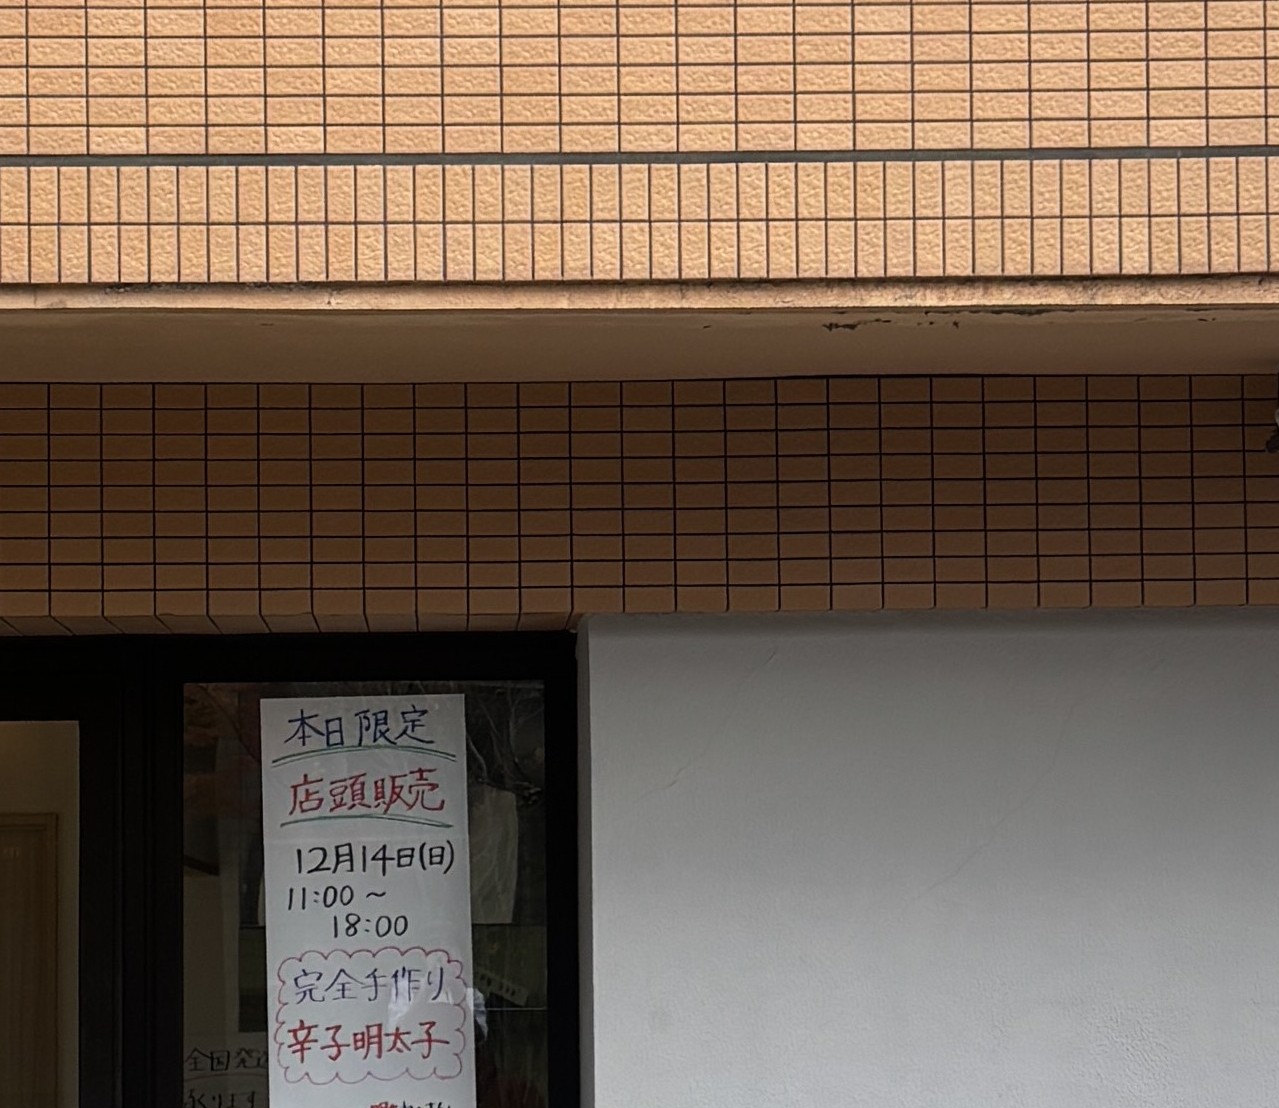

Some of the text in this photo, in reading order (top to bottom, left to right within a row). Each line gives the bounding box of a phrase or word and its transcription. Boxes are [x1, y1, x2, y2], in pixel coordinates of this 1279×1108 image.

[283, 705, 435, 747] 本日限定
[288, 768, 446, 815] 店頭販売
[333, 914, 409, 938] 18:00
[293, 967, 445, 1004] 完全手作り
[287, 1020, 449, 1063] 辛子明太子
